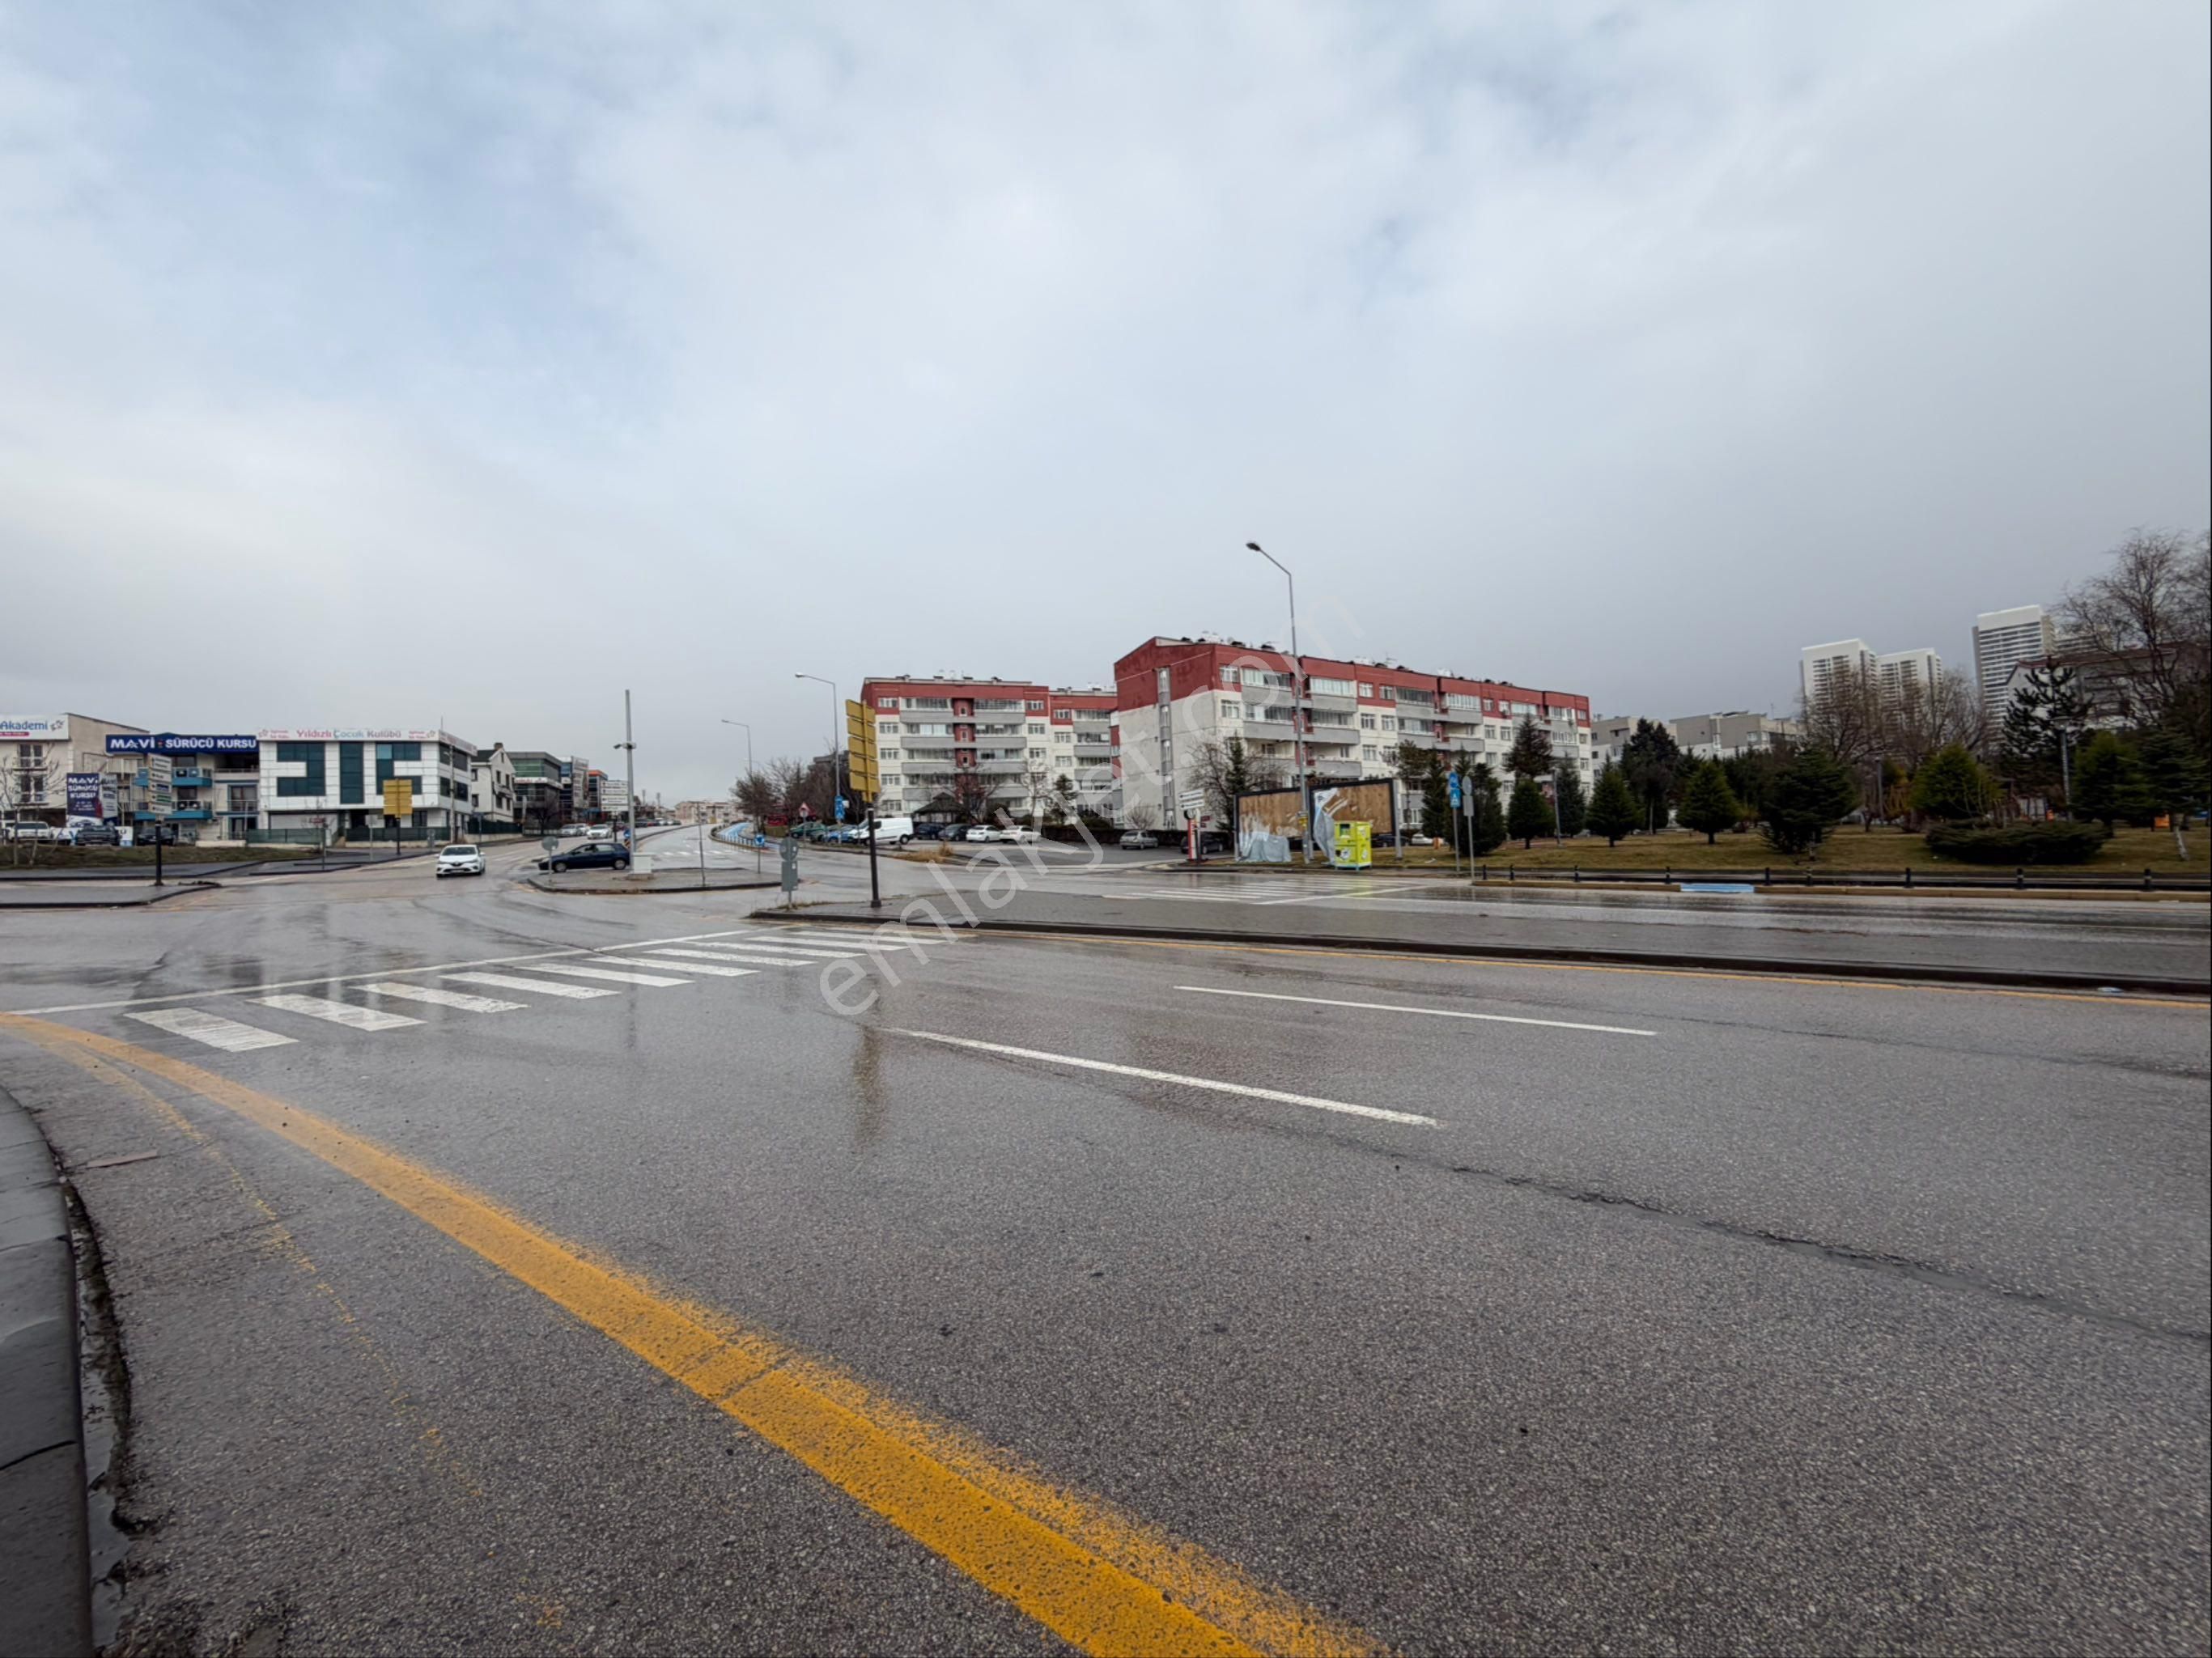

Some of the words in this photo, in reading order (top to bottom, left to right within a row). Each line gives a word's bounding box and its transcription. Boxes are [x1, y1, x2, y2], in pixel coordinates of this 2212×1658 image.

[0, 720, 48, 730] Akademi
[367, 730, 401, 738] Kulübü
[165, 737, 214, 748] SÜRÜCÜ
[217, 739, 257, 748] KURSU
